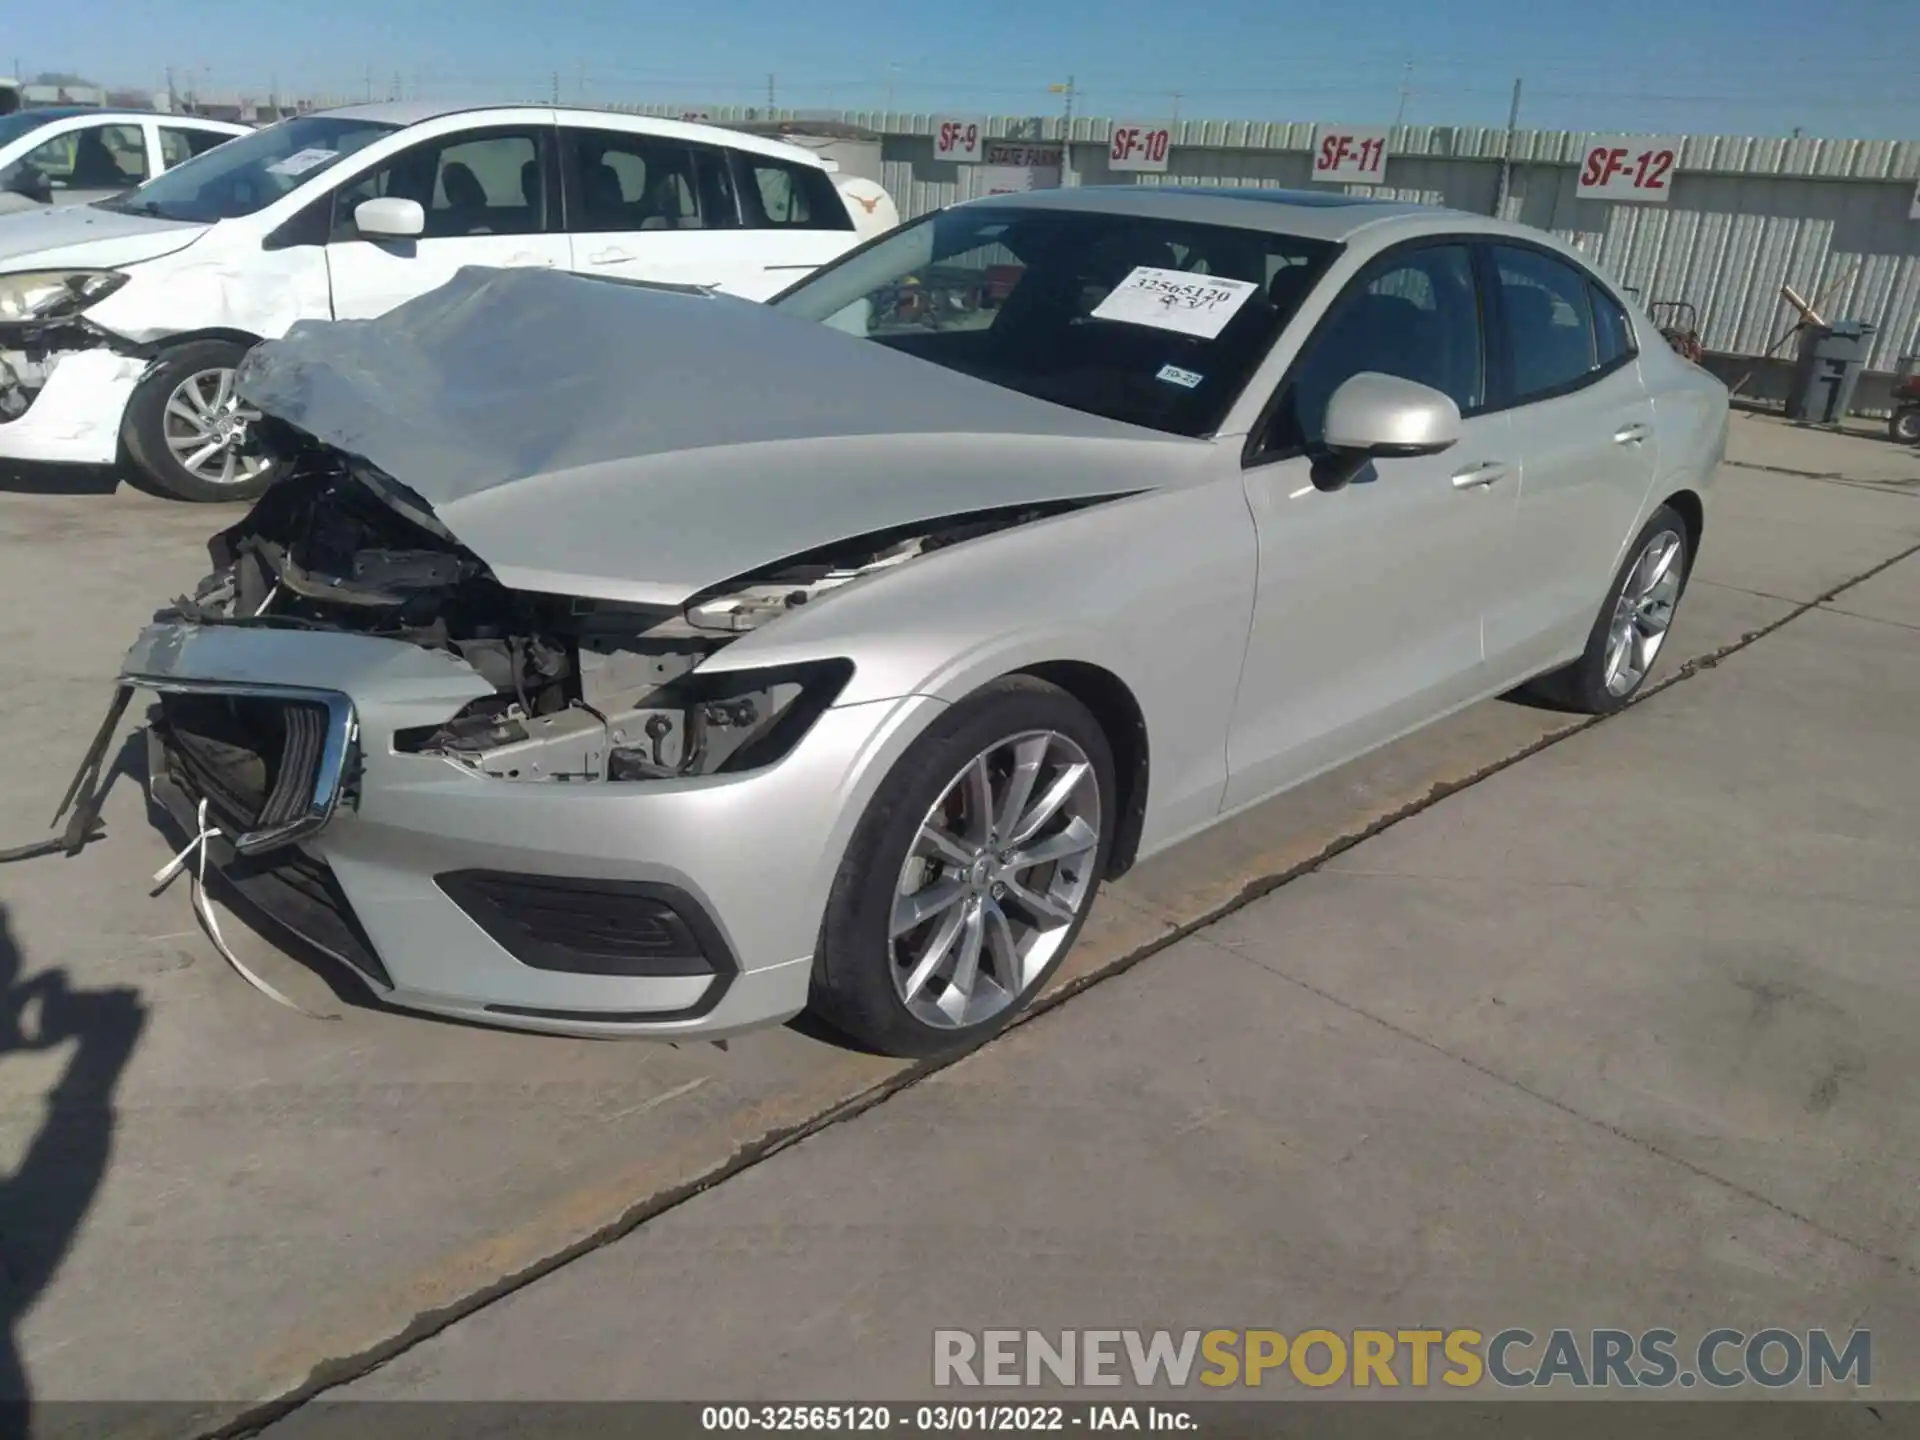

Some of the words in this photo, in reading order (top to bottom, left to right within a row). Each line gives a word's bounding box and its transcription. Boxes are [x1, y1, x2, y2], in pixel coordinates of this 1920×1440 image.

[939, 121, 977, 153] SF-9
[1111, 127, 1170, 162] SF-10
[1316, 135, 1386, 172] SF-11
[1582, 147, 1673, 188] SF-12
